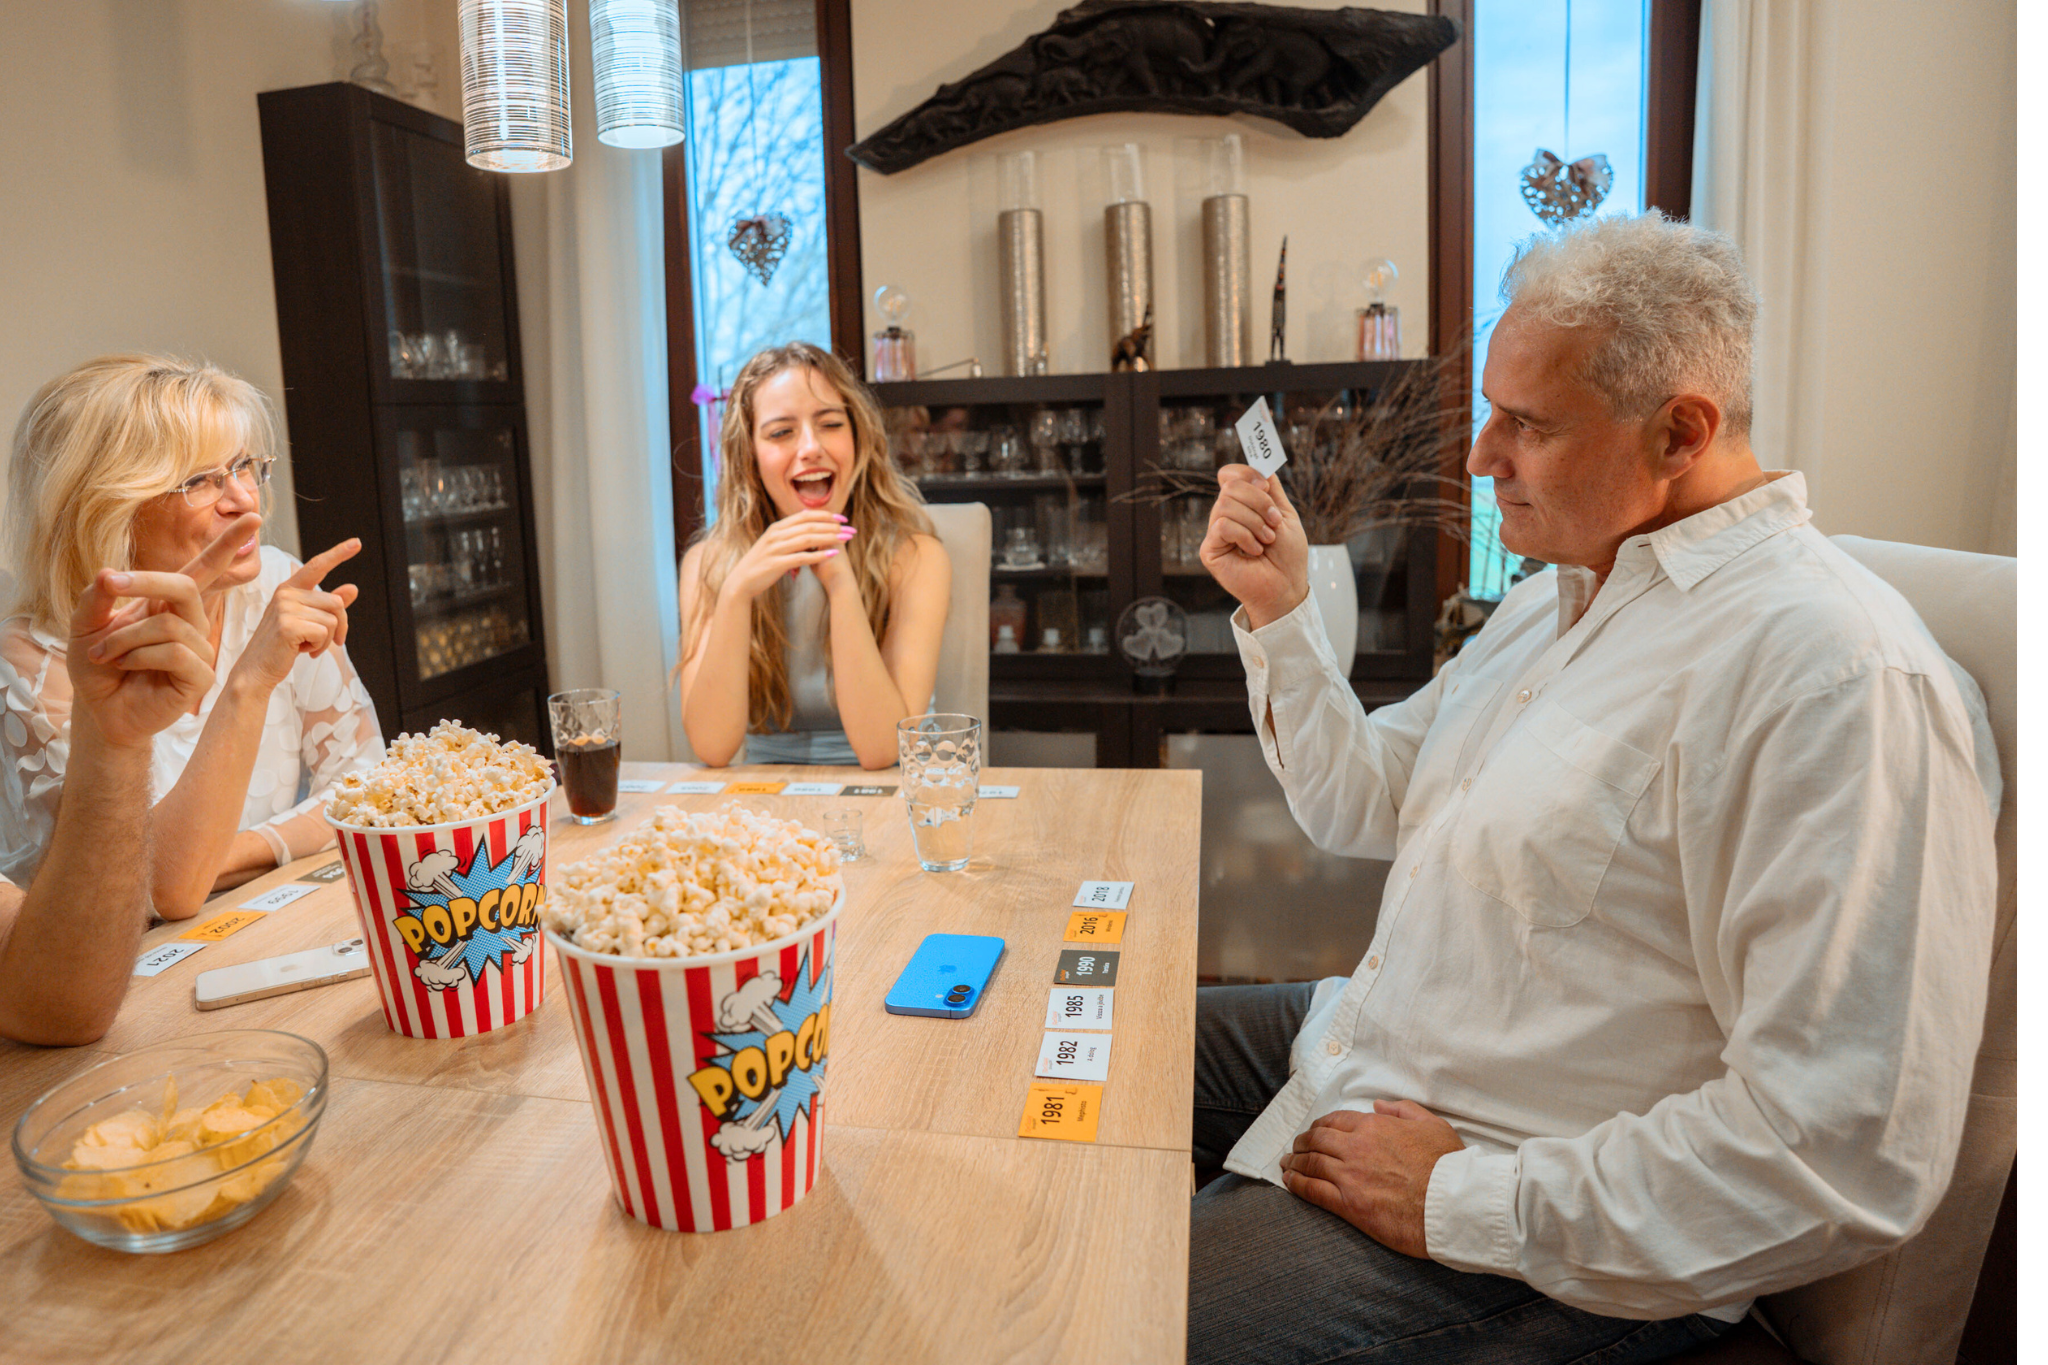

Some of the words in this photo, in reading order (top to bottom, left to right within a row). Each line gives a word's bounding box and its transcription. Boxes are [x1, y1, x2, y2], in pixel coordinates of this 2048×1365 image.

[1253, 421, 1272, 459] 1980
[1091, 886, 1110, 902] 2018
[209, 917, 245, 934] 2002
[1079, 917, 1098, 935] 2016
[146, 949, 185, 966] 2021
[1076, 956, 1096, 976] 1990
[1065, 995, 1084, 1018] 1985
[687, 1002, 831, 1117] POPCO
[1056, 1040, 1078, 1066] 1982
[1040, 1096, 1065, 1125] 1981
[1077, 1100, 1087, 1122] Mephisto
